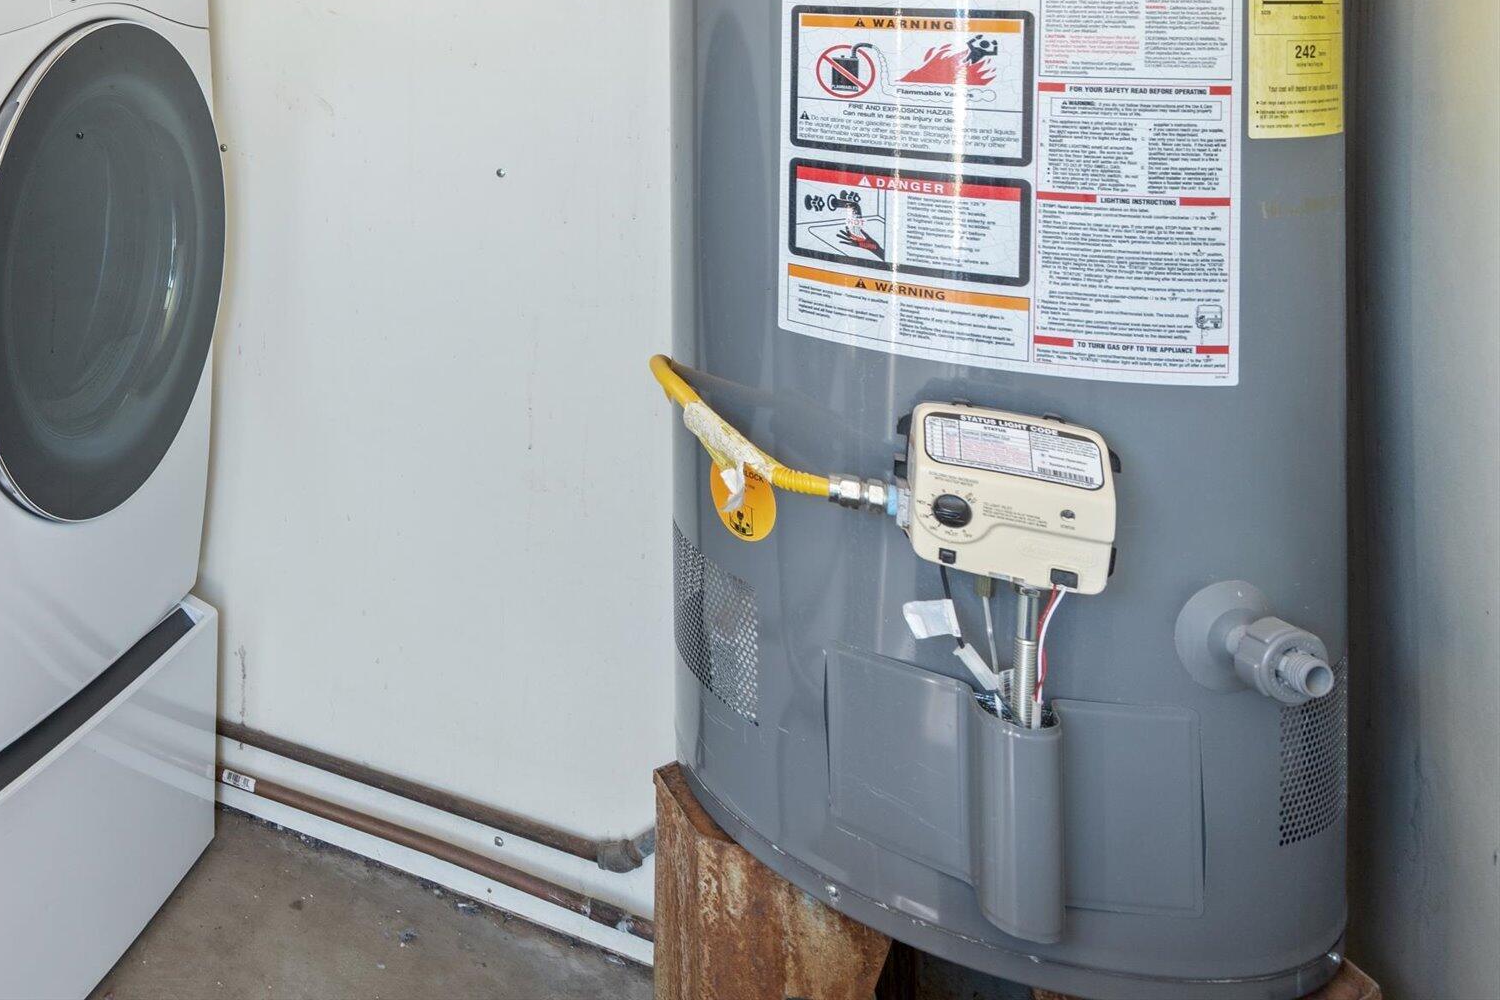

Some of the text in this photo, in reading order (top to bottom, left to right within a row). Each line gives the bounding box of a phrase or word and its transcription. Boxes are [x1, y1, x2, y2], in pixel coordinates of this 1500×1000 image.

[872, 18, 955, 30] WARNING
[1295, 44, 1316, 59] 242
[896, 88, 942, 97] Flammable
[876, 178, 944, 194] DANGER
[875, 282, 946, 300] WARNING
[1159, 345, 1193, 354] APPLIANCE
[960, 414, 1059, 436] STATUS LIGHT CODE
